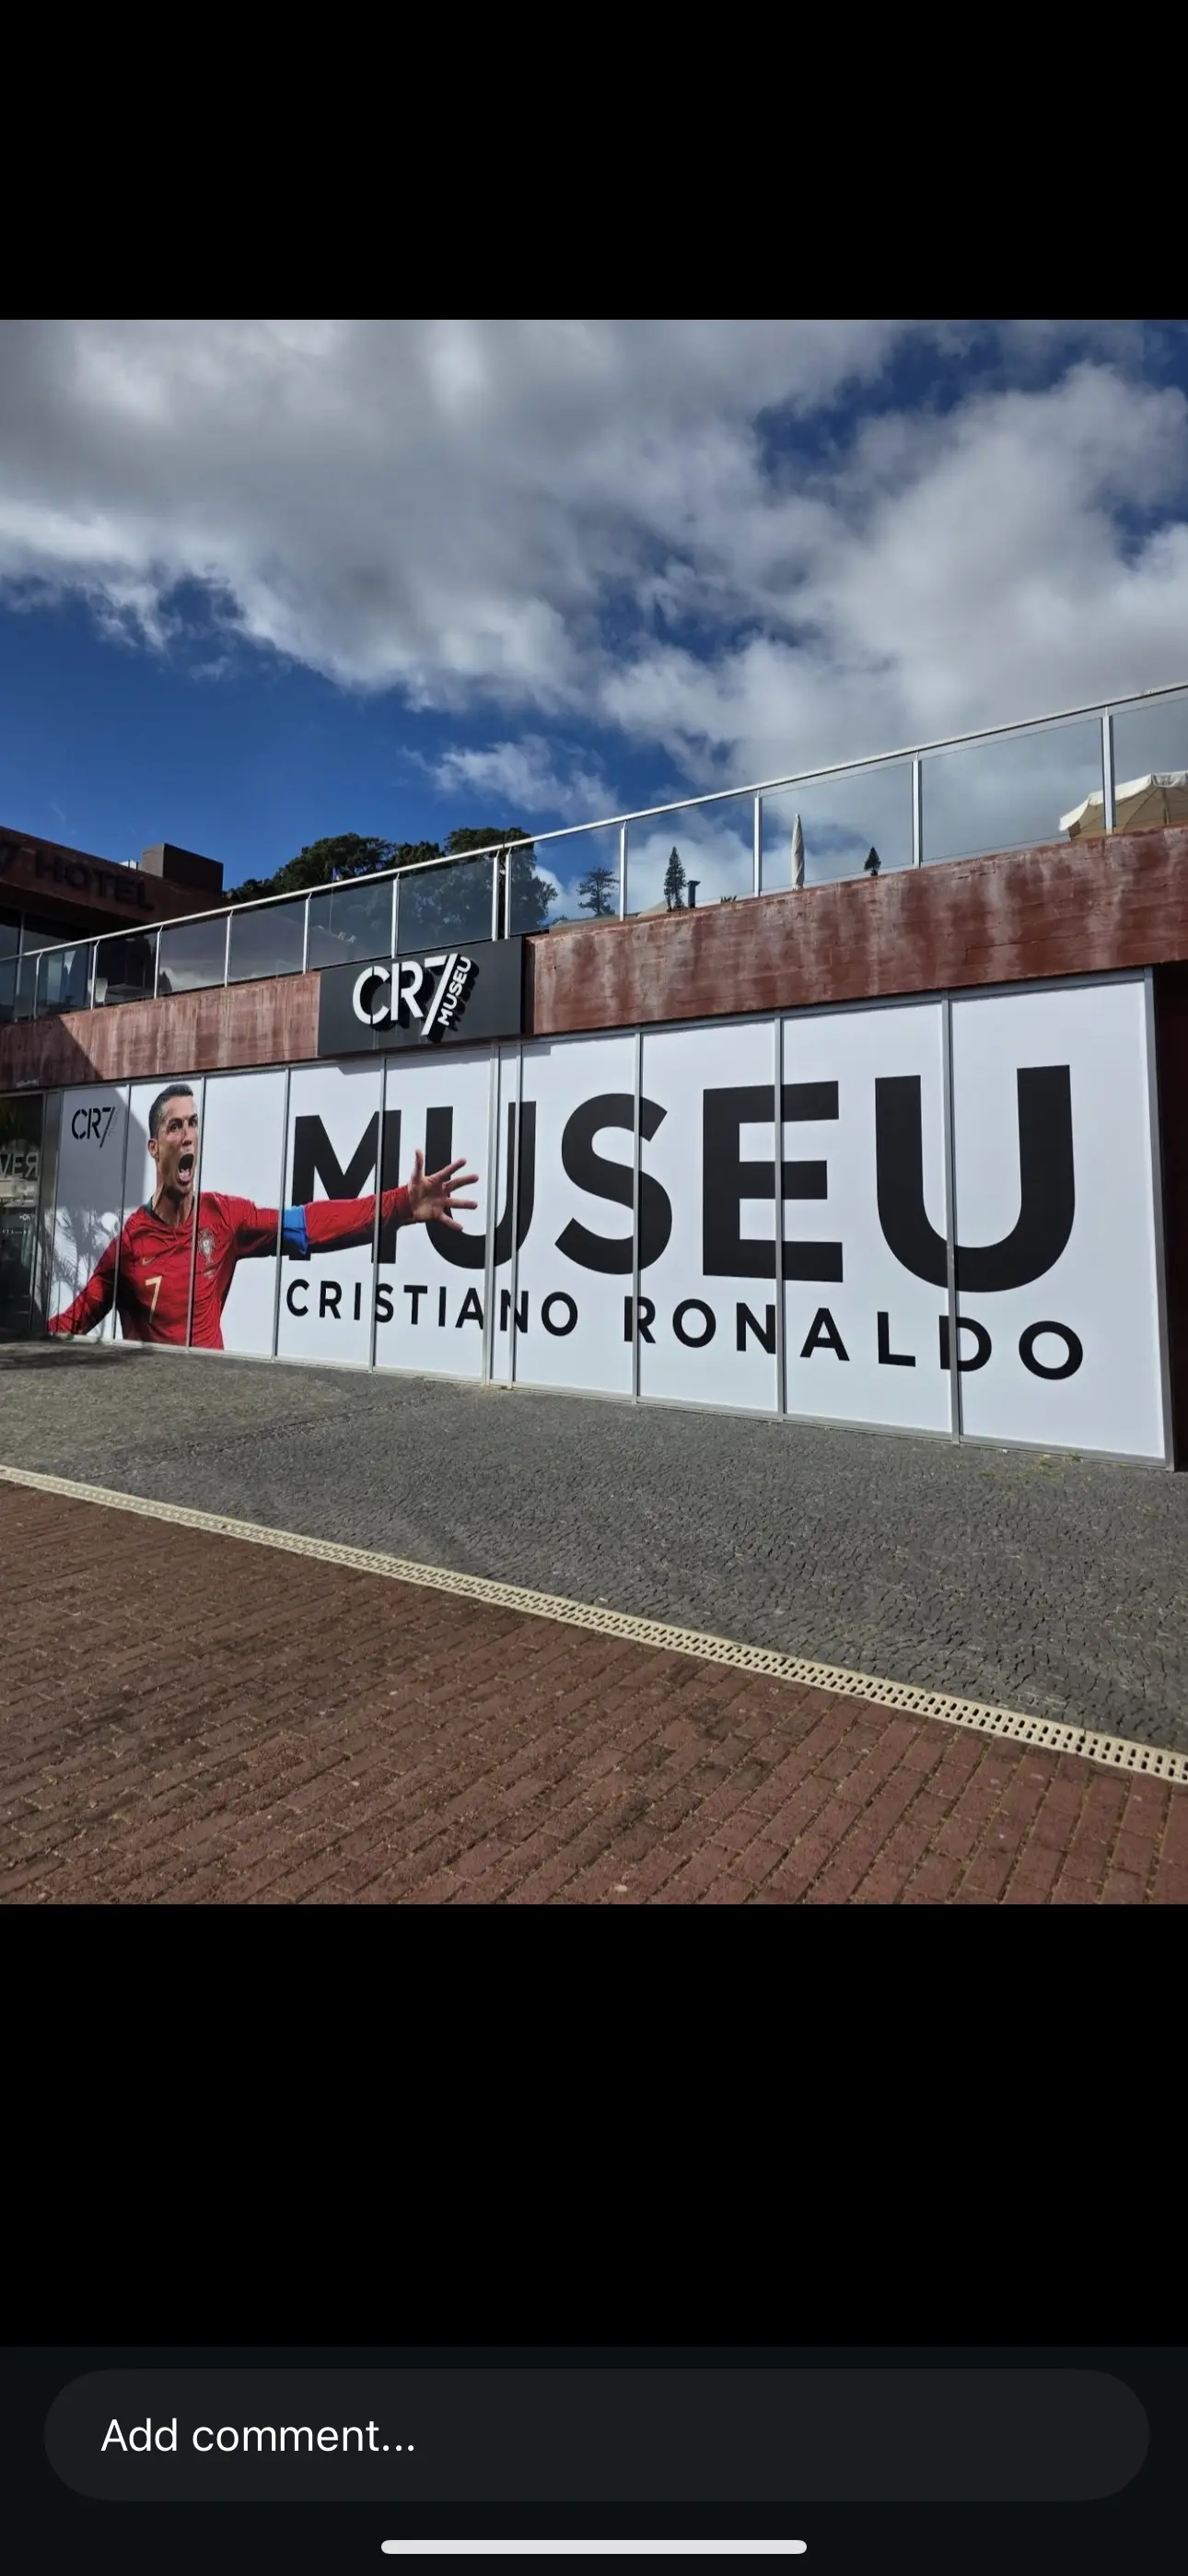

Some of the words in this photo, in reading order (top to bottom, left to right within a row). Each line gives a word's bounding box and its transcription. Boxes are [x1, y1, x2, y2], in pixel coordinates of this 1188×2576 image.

[34, 848, 155, 911] HOTEL
[352, 953, 459, 1036] CR7
[437, 955, 472, 1026] MUSEU
[71, 1106, 116, 1149] CR7
[288, 1064, 1077, 1294] MUSEU
[145, 1275, 164, 1324] 7
[285, 1278, 579, 1338] CRISTIANO
[623, 1294, 1085, 1381] RONALDO
